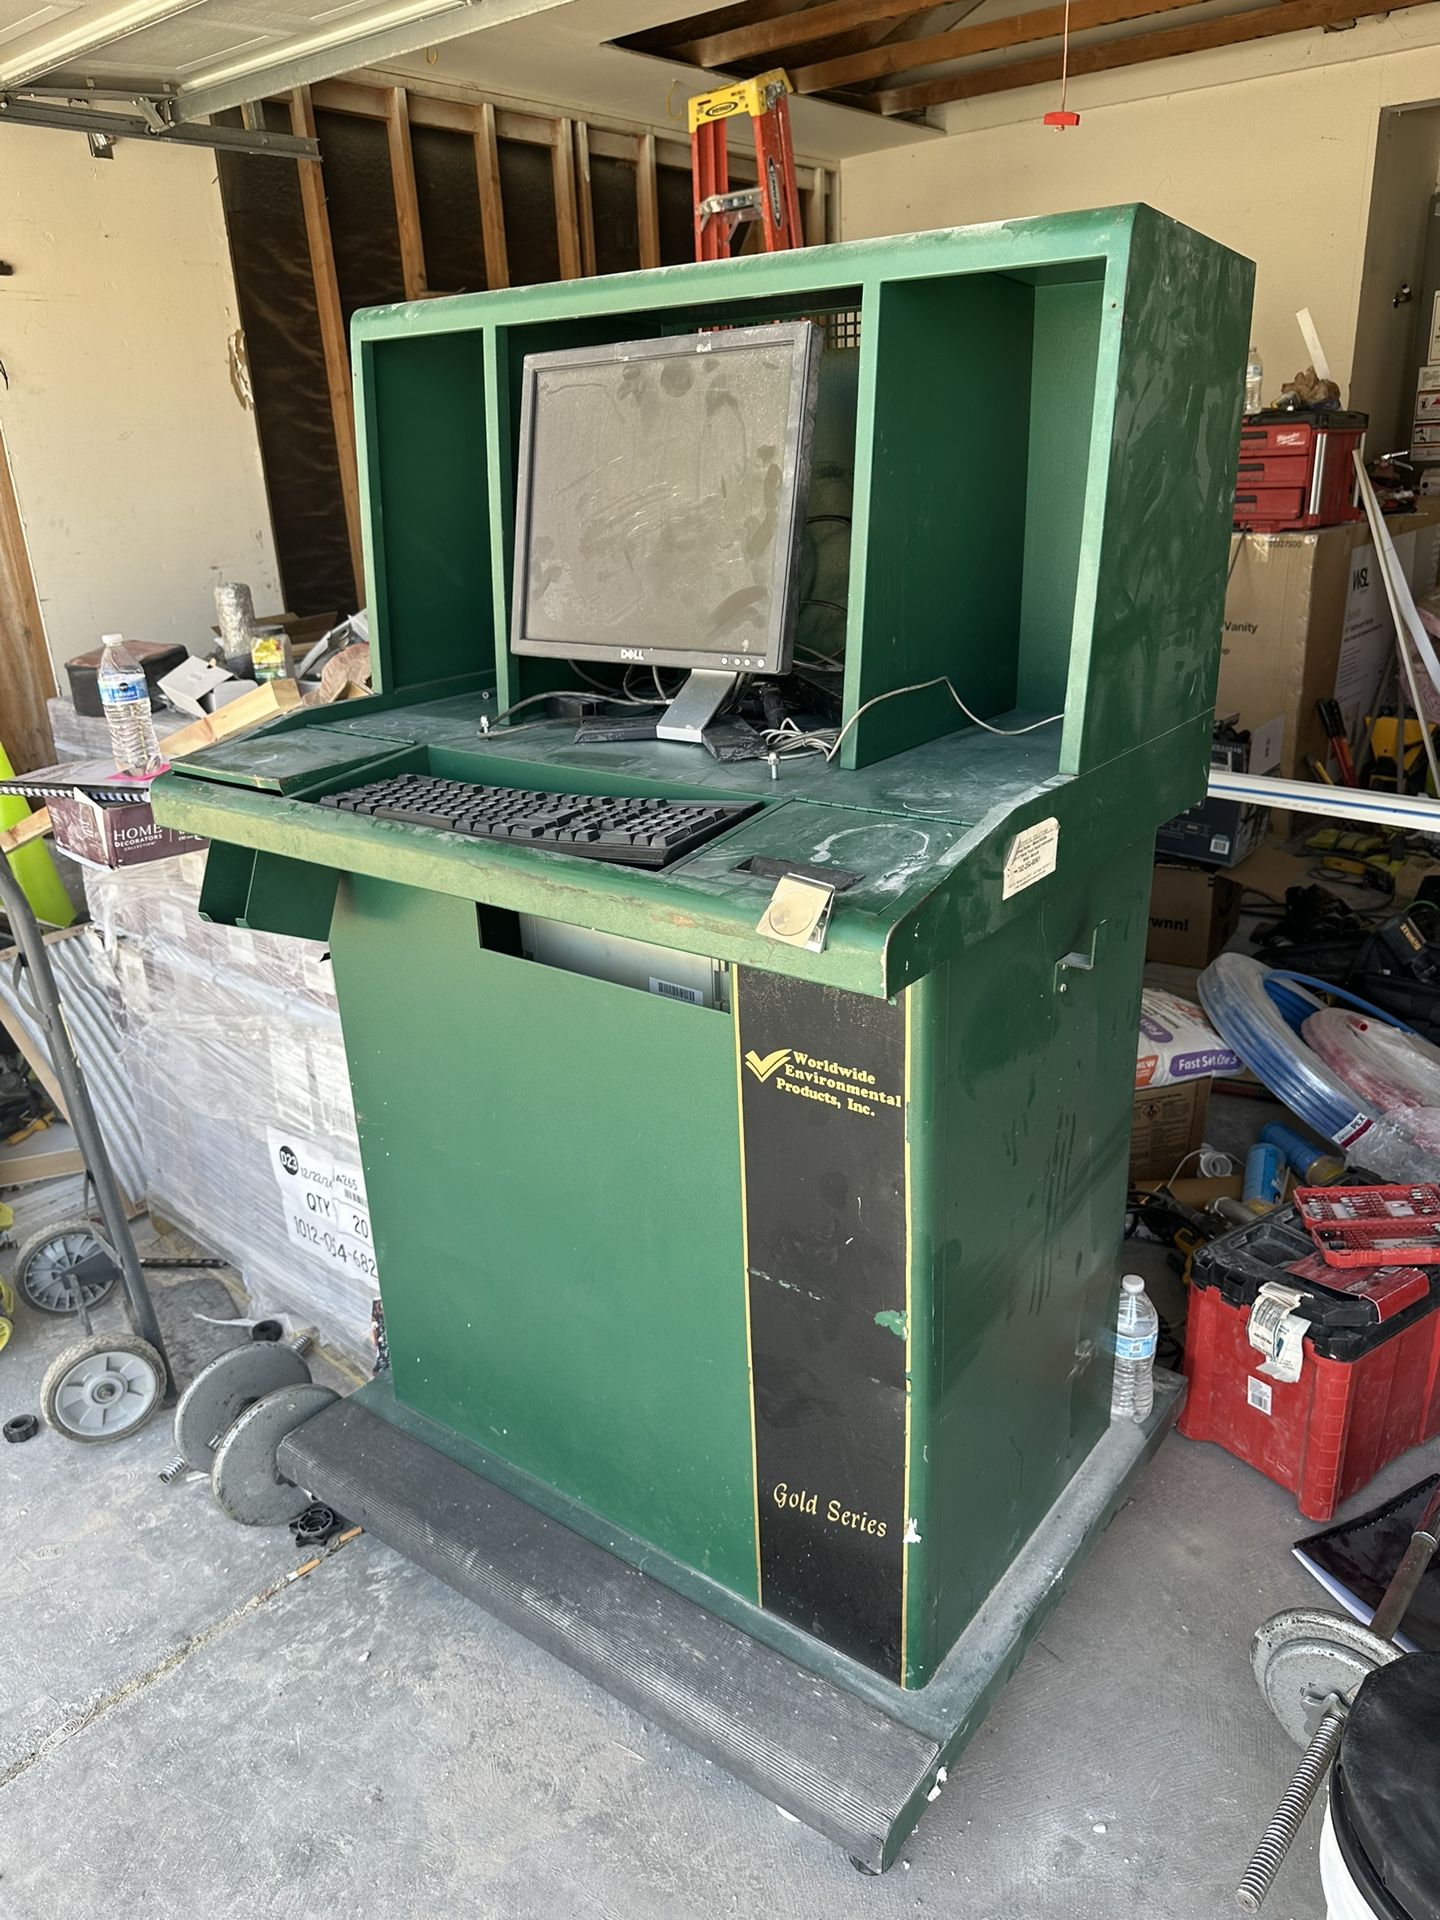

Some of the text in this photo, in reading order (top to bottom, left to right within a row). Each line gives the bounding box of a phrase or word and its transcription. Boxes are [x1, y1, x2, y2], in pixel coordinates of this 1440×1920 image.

[1224, 621, 1258, 634] Vanity
[621, 649, 645, 661] DELL
[113, 823, 163, 841] HOME
[114, 834, 163, 848] DECORATORS
[1149, 916, 1189, 931] wnn!
[793, 1050, 876, 1085] Worldwide
[1179, 1058, 1201, 1071] Fast
[784, 1063, 902, 1108] Environmental
[775, 1077, 876, 1117] Products, Inc.
[1350, 1115, 1366, 1130] PEX
[280, 1151, 298, 1171] D23
[306, 1192, 369, 1239] QTY 20
[773, 1482, 888, 1538] Gold Series
